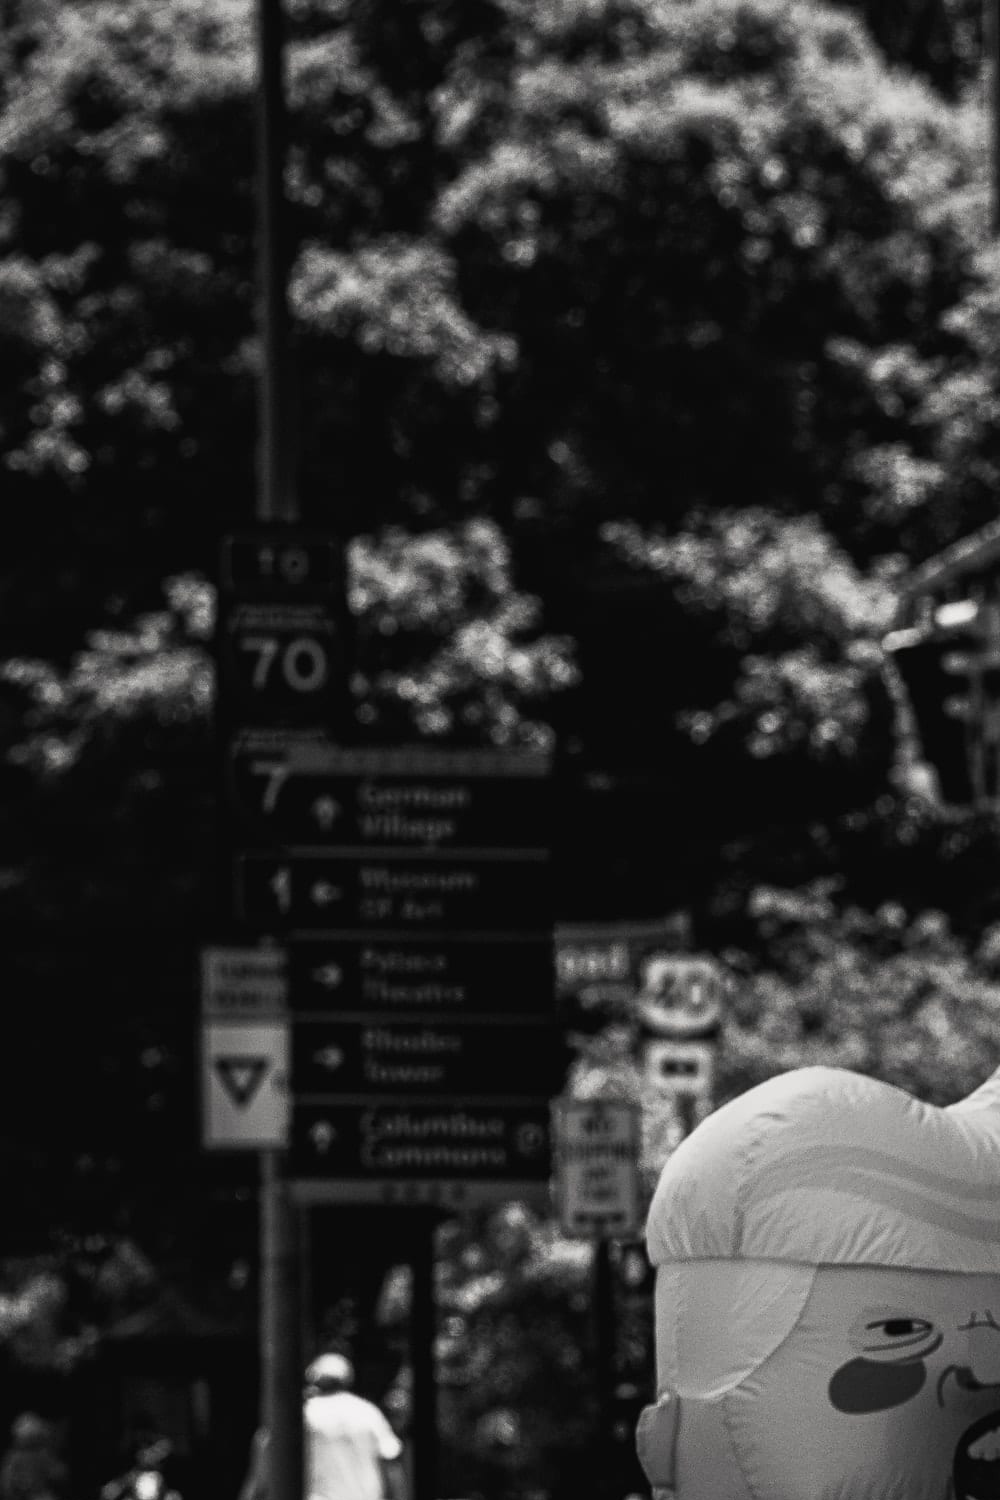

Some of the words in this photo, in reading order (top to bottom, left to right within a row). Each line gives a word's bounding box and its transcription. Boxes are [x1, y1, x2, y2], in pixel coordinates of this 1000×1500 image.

[239, 635, 328, 692] 70
[358, 783, 471, 809] German
[358, 813, 456, 848] Village
[359, 866, 478, 891] Museum
[358, 1109, 504, 1137] Columbus
[360, 1137, 506, 1168] Commons
